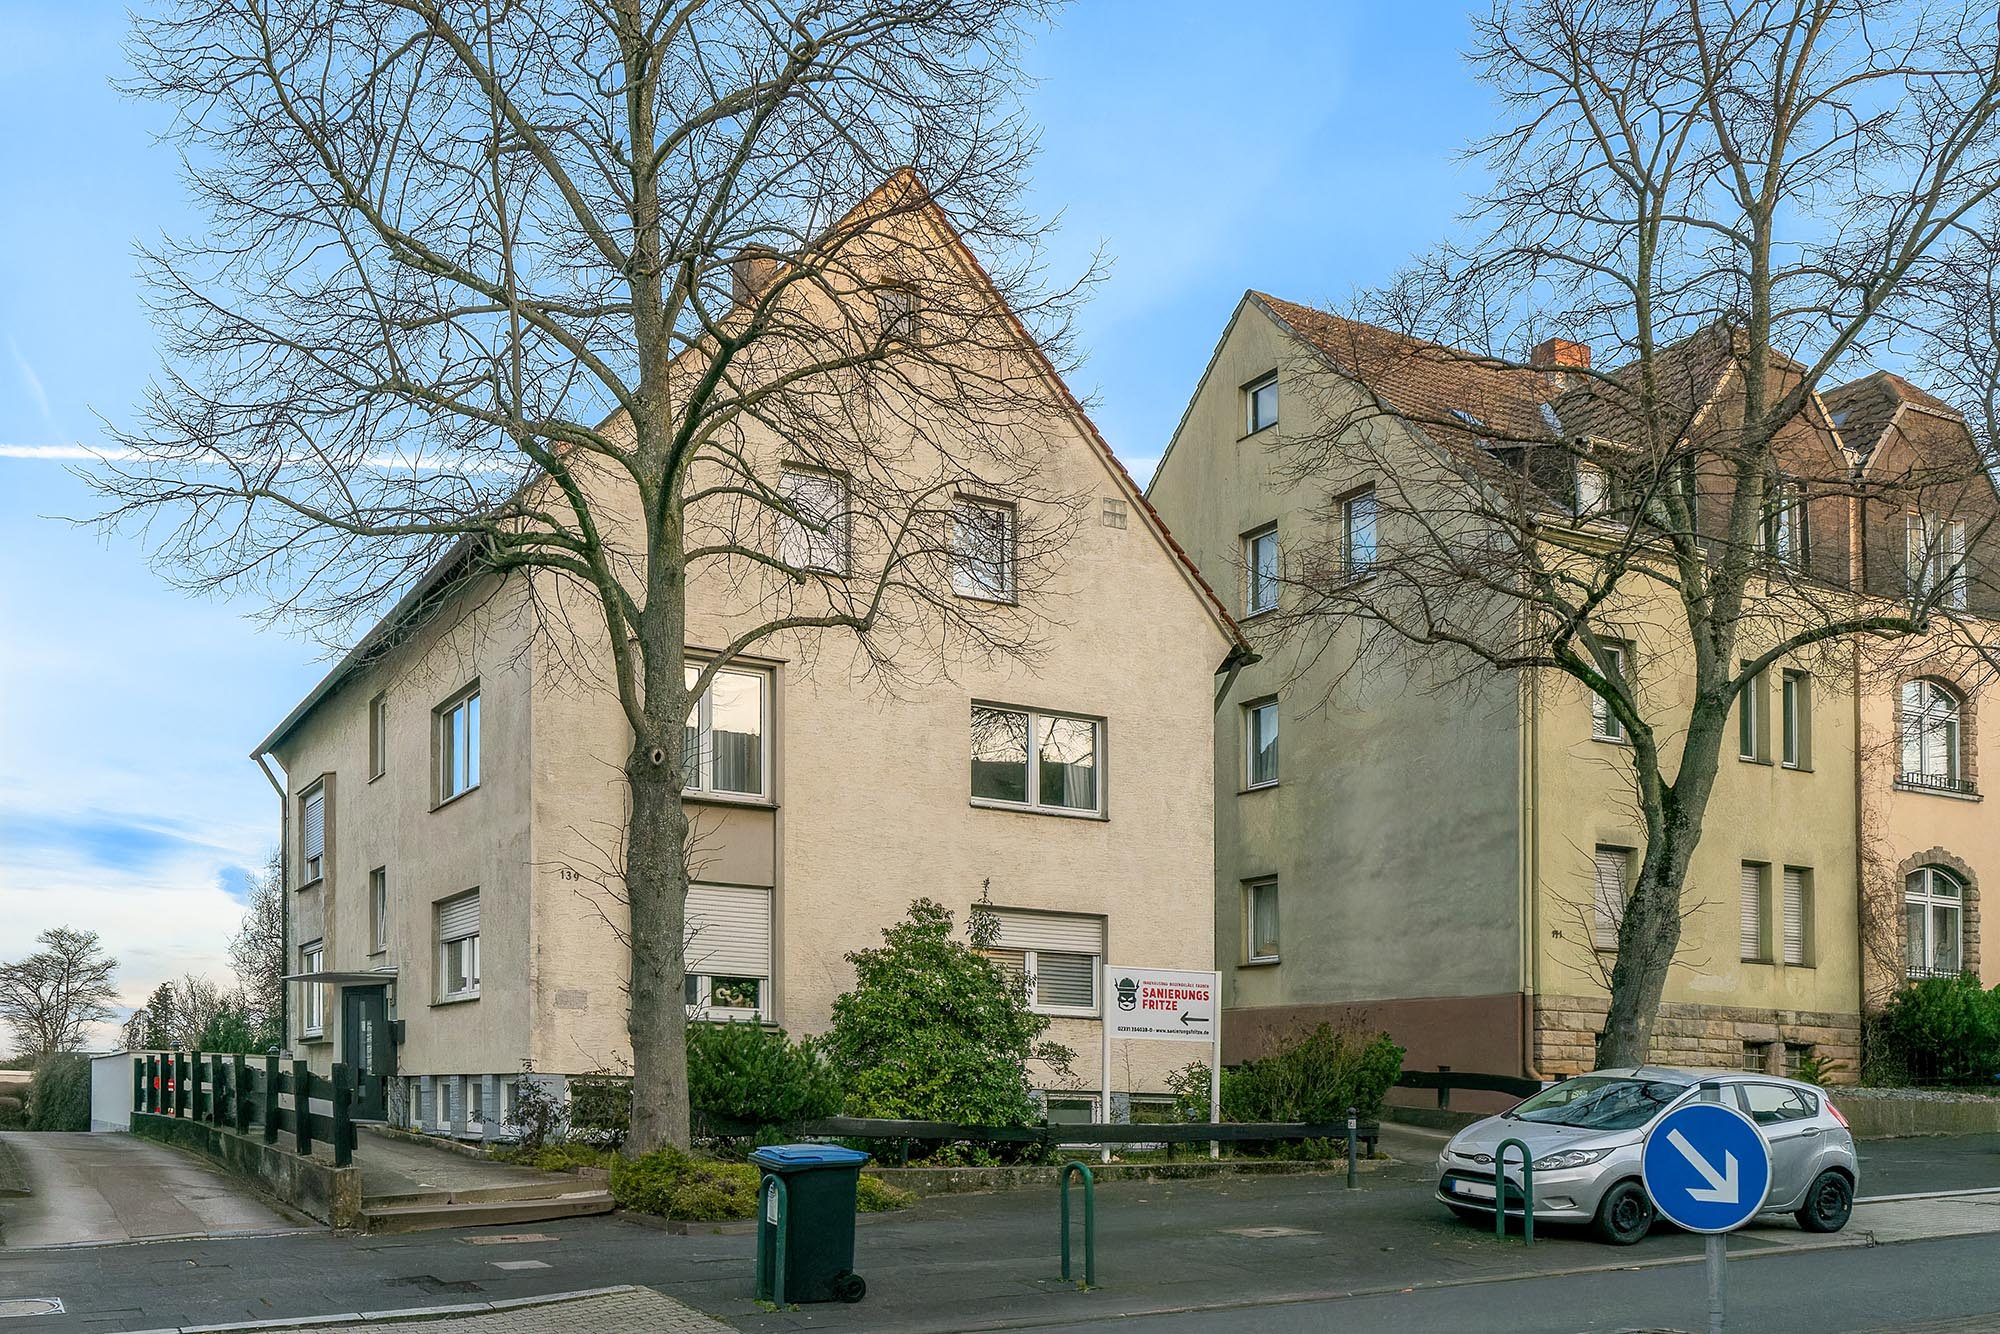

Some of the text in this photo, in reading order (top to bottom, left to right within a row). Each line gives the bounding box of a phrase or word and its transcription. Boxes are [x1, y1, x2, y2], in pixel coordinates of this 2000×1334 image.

[560, 870, 580, 881] 139
[1142, 988, 1209, 1001] SANIERUNGS
[1142, 999, 1178, 1011] FRITZE
